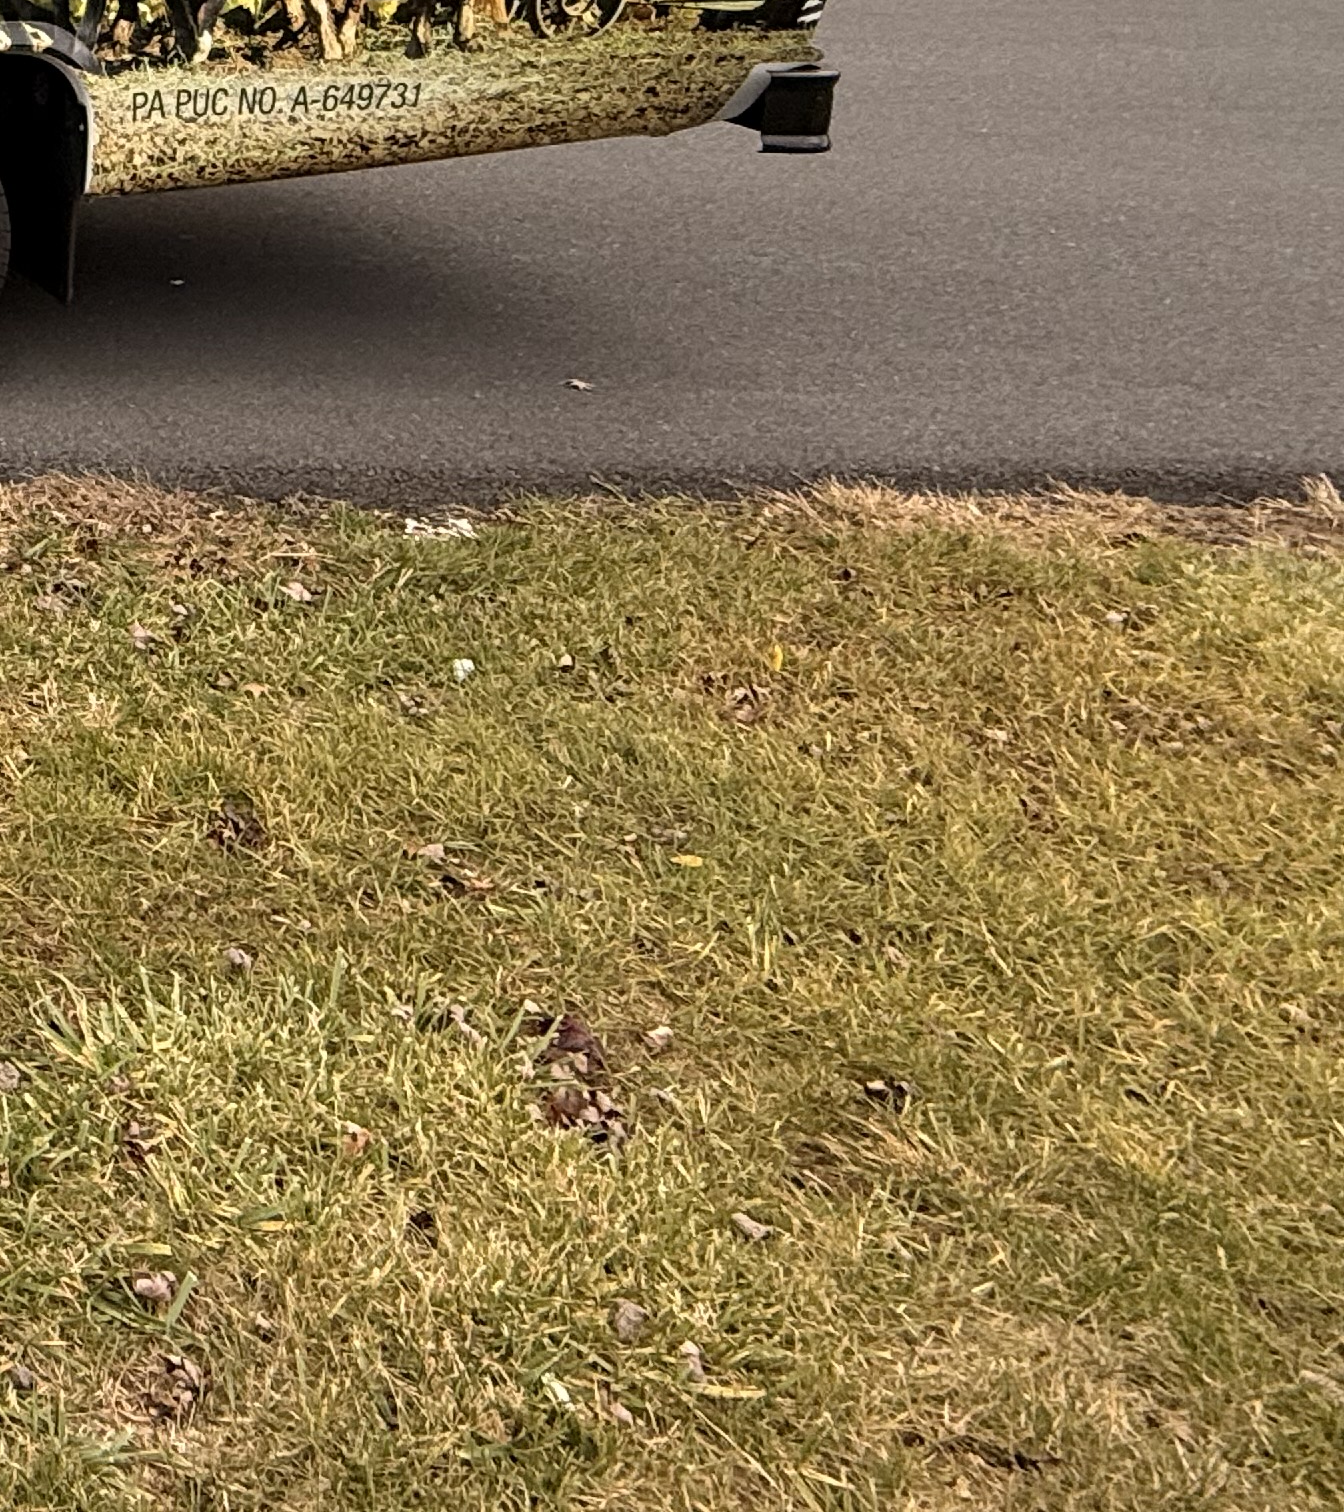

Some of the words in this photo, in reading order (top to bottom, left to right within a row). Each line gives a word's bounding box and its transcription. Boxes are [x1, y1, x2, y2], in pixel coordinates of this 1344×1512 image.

[131, 90, 166, 122] PA
[175, 87, 229, 117] PUC
[238, 86, 284, 115] NO.
[289, 82, 422, 114] A-649731
